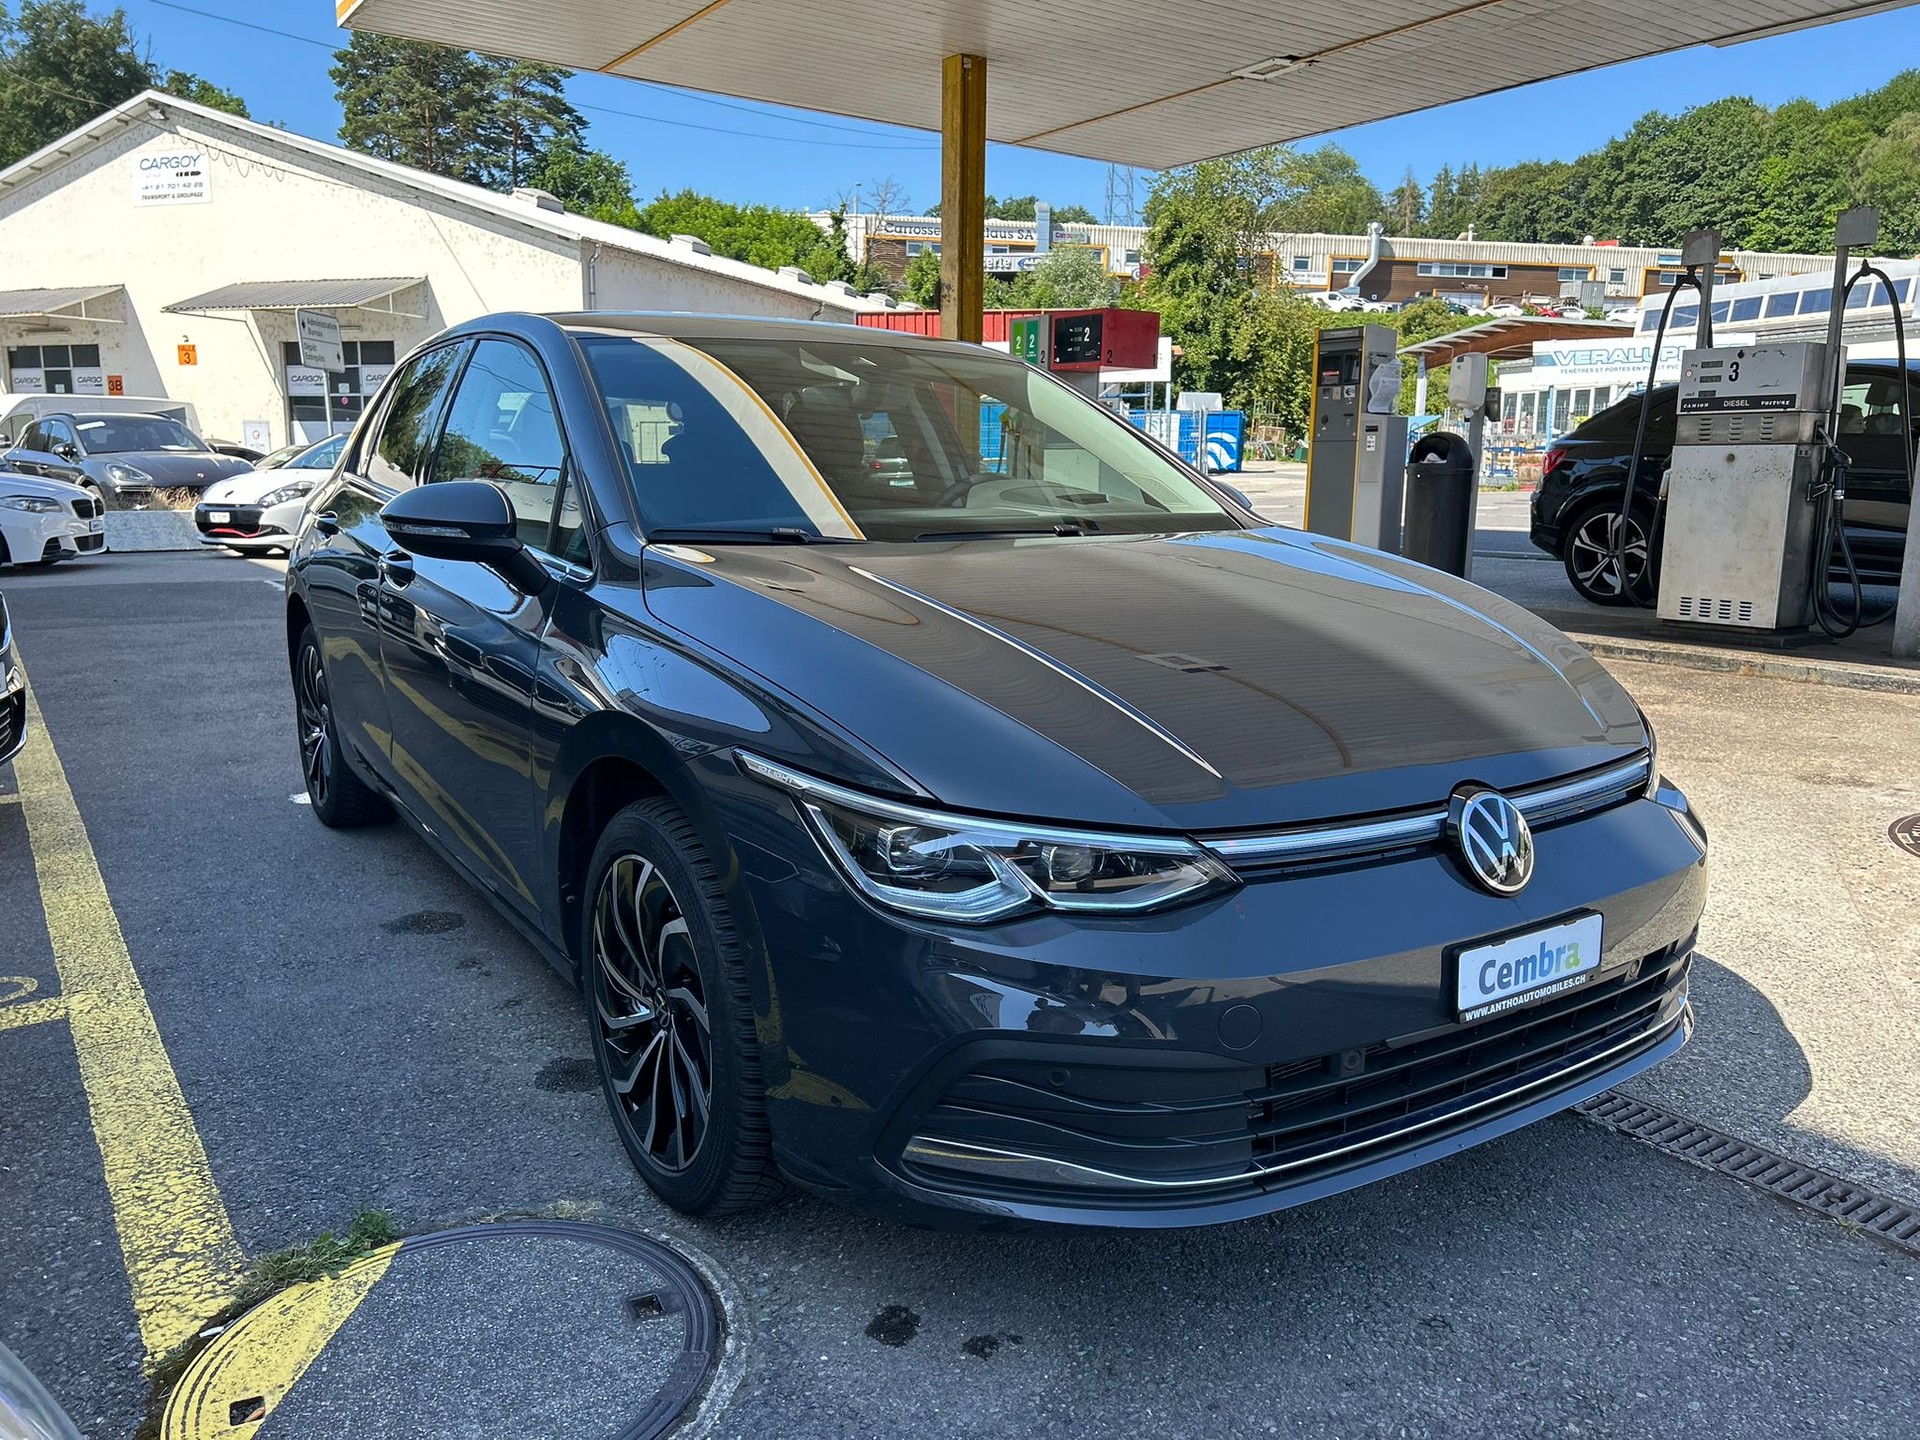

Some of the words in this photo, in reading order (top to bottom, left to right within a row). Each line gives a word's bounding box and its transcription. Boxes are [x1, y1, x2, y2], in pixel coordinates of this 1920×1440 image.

[140, 155, 200, 170] CARGOY
[885, 222, 941, 236] Carrosse
[986, 227, 1013, 239] laus
[1017, 228, 1034, 240] SA
[1029, 334, 1034, 348] 2
[1084, 326, 1090, 342] 2
[1015, 336, 1021, 350] 2
[184, 352, 191, 364] 3
[1040, 350, 1046, 364] 2
[1106, 350, 1113, 364] 2
[1728, 362, 1740, 382] 3
[77, 376, 102, 384] CARGO
[108, 380, 122, 392] 3B
[1724, 400, 1750, 408] DIESEL
[1478, 941, 1580, 995] Cembra
[1465, 974, 1586, 1022] WWW.ANTHOAUTOMOBILES.CH
